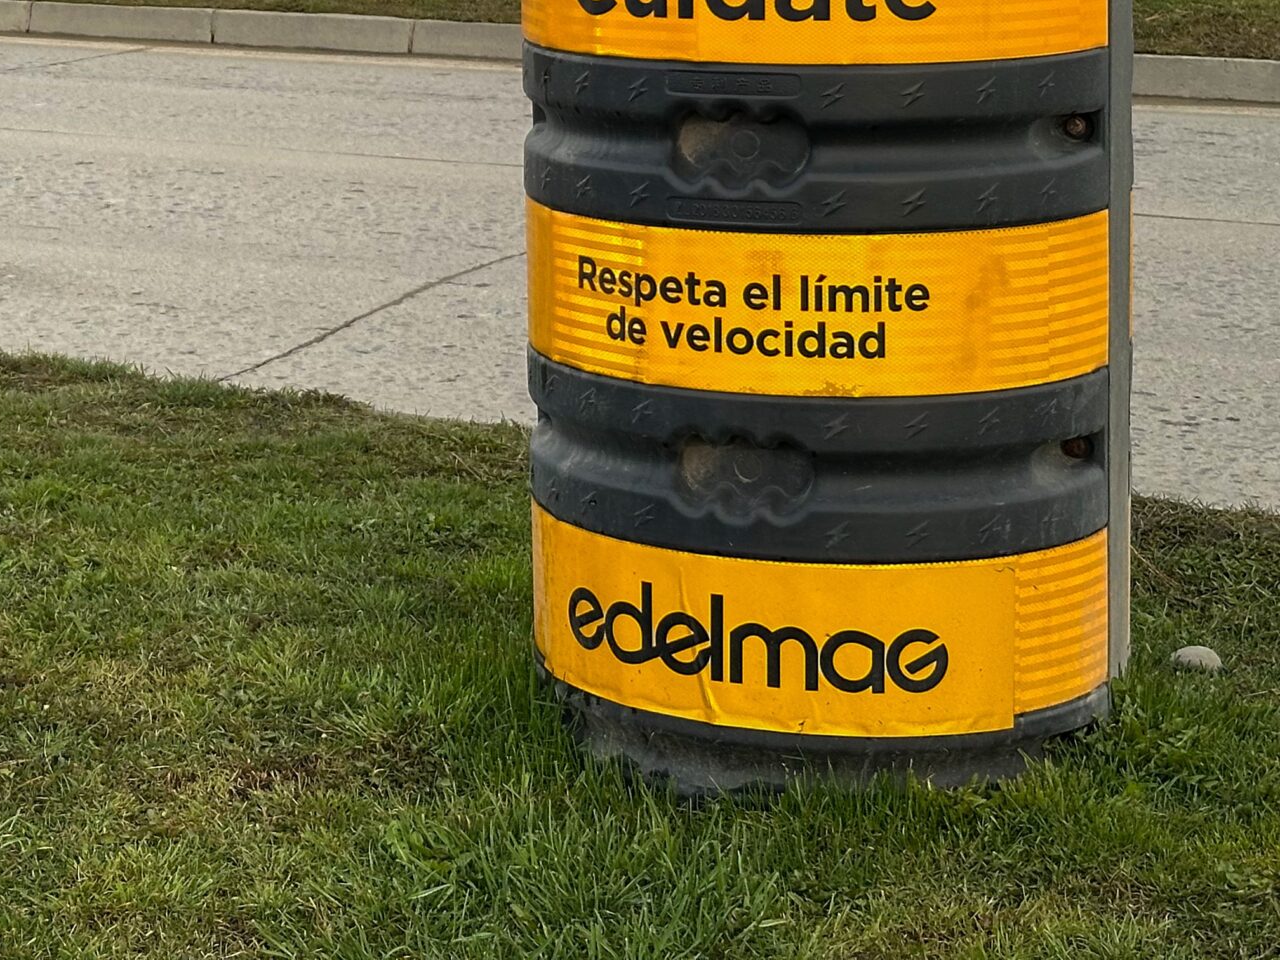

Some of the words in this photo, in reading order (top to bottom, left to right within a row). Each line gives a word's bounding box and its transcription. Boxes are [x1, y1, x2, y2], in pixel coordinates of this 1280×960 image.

[578, 256, 726, 310] Respeta
[742, 274, 781, 312] el
[800, 274, 930, 313] límite
[606, 306, 647, 345] de
[660, 320, 886, 359] velocidad
[568, 581, 949, 694] edelmag
